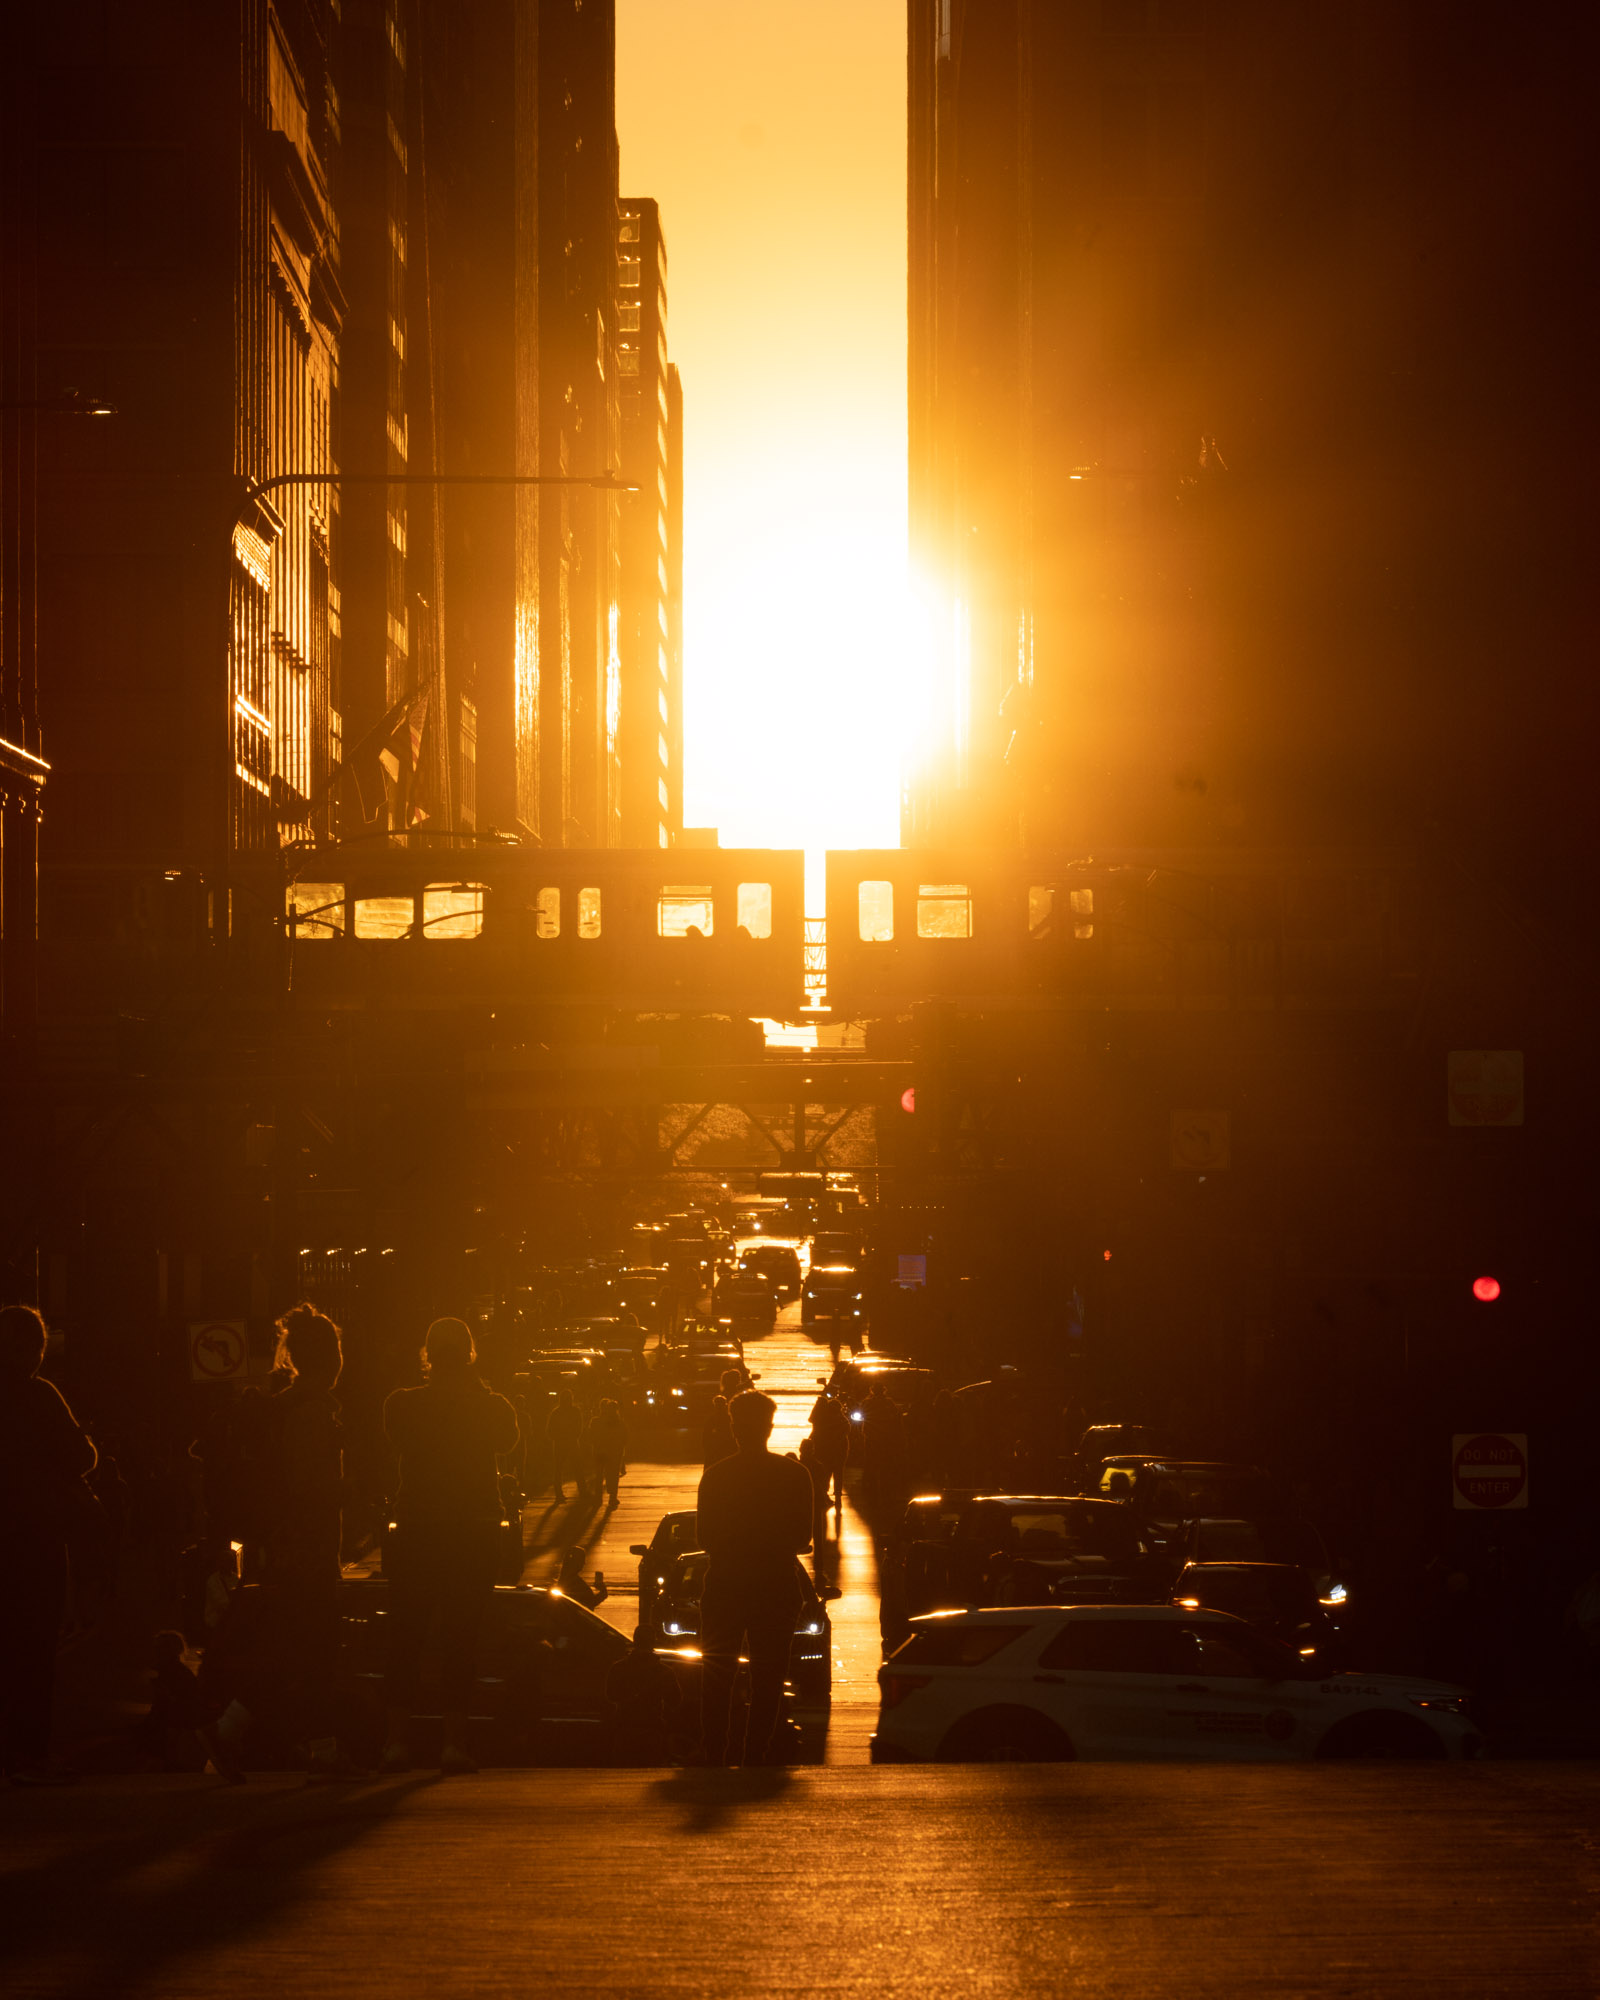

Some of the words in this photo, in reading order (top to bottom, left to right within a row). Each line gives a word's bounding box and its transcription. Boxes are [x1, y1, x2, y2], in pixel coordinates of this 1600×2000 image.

[1463, 1449, 1481, 1460] DO
[1489, 1449, 1515, 1461] NOT
[1470, 1481, 1510, 1495] ENTER
